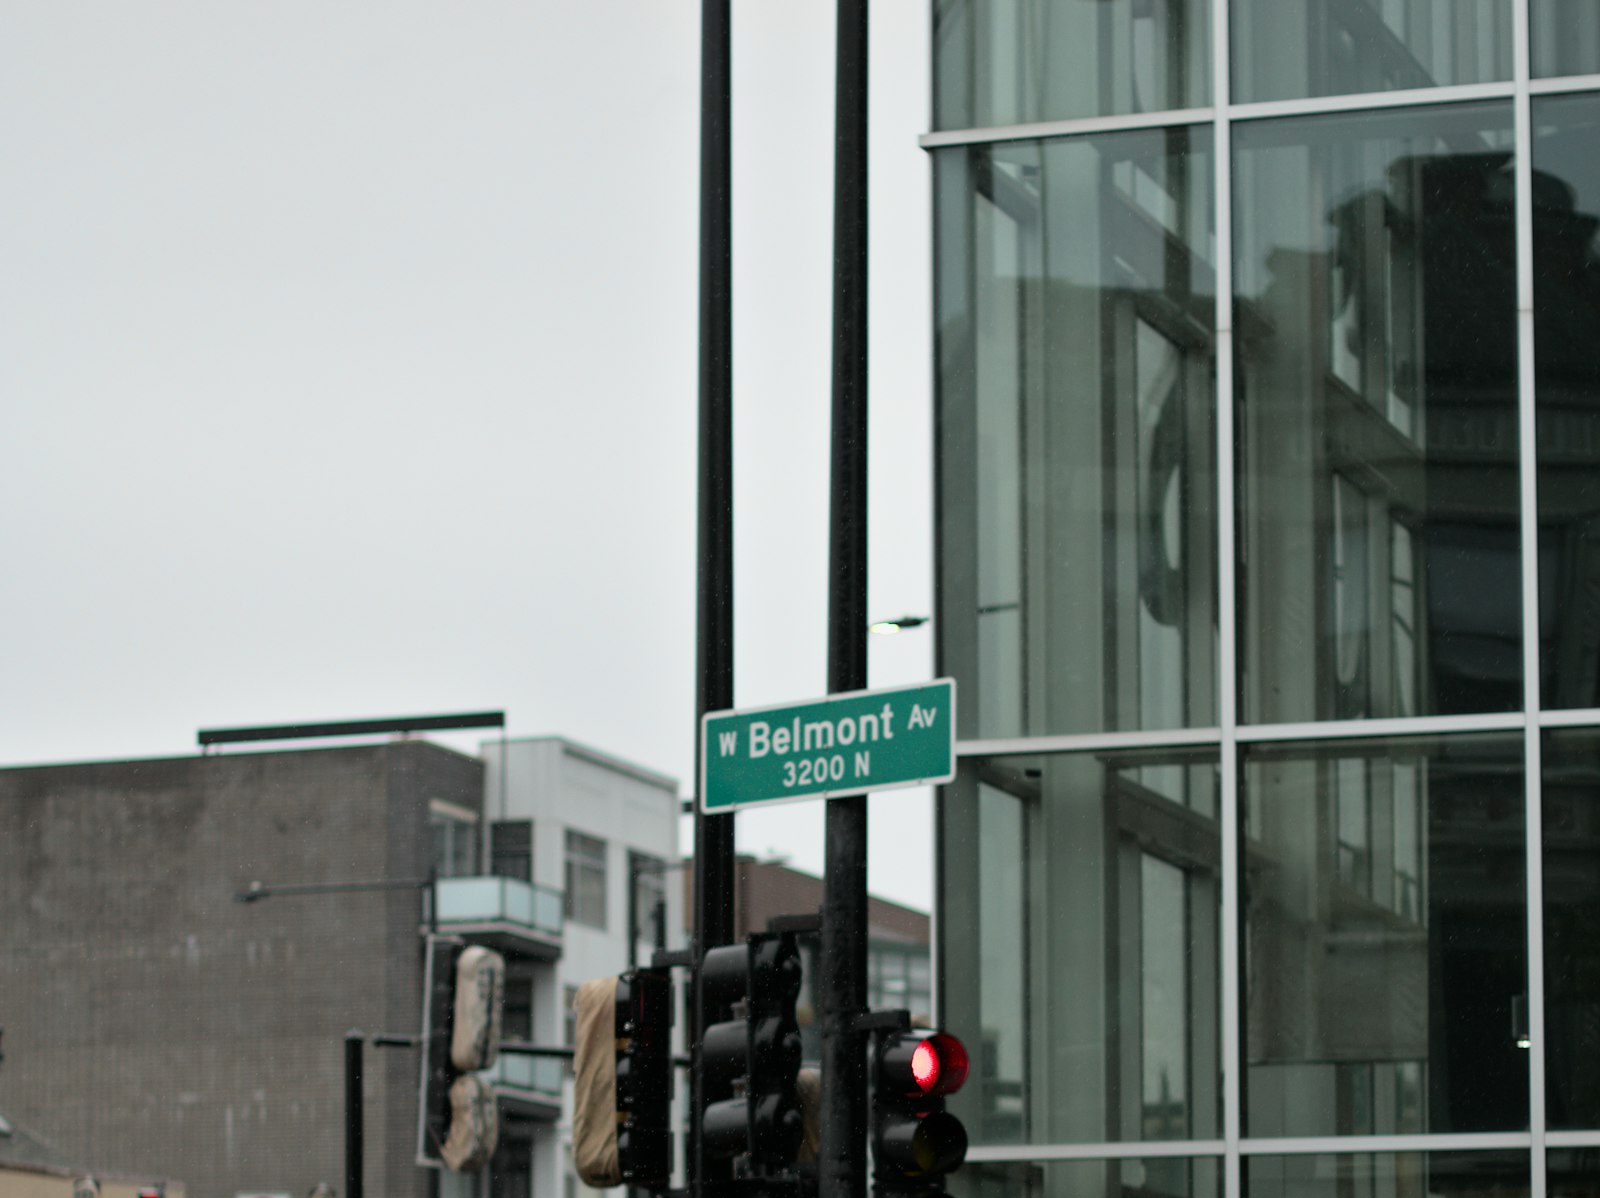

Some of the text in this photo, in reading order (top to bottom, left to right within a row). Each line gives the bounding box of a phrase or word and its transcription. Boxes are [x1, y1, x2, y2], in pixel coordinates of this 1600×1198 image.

[719, 703, 937, 759] W Belmont Av
[783, 751, 870, 787] 3200 N
